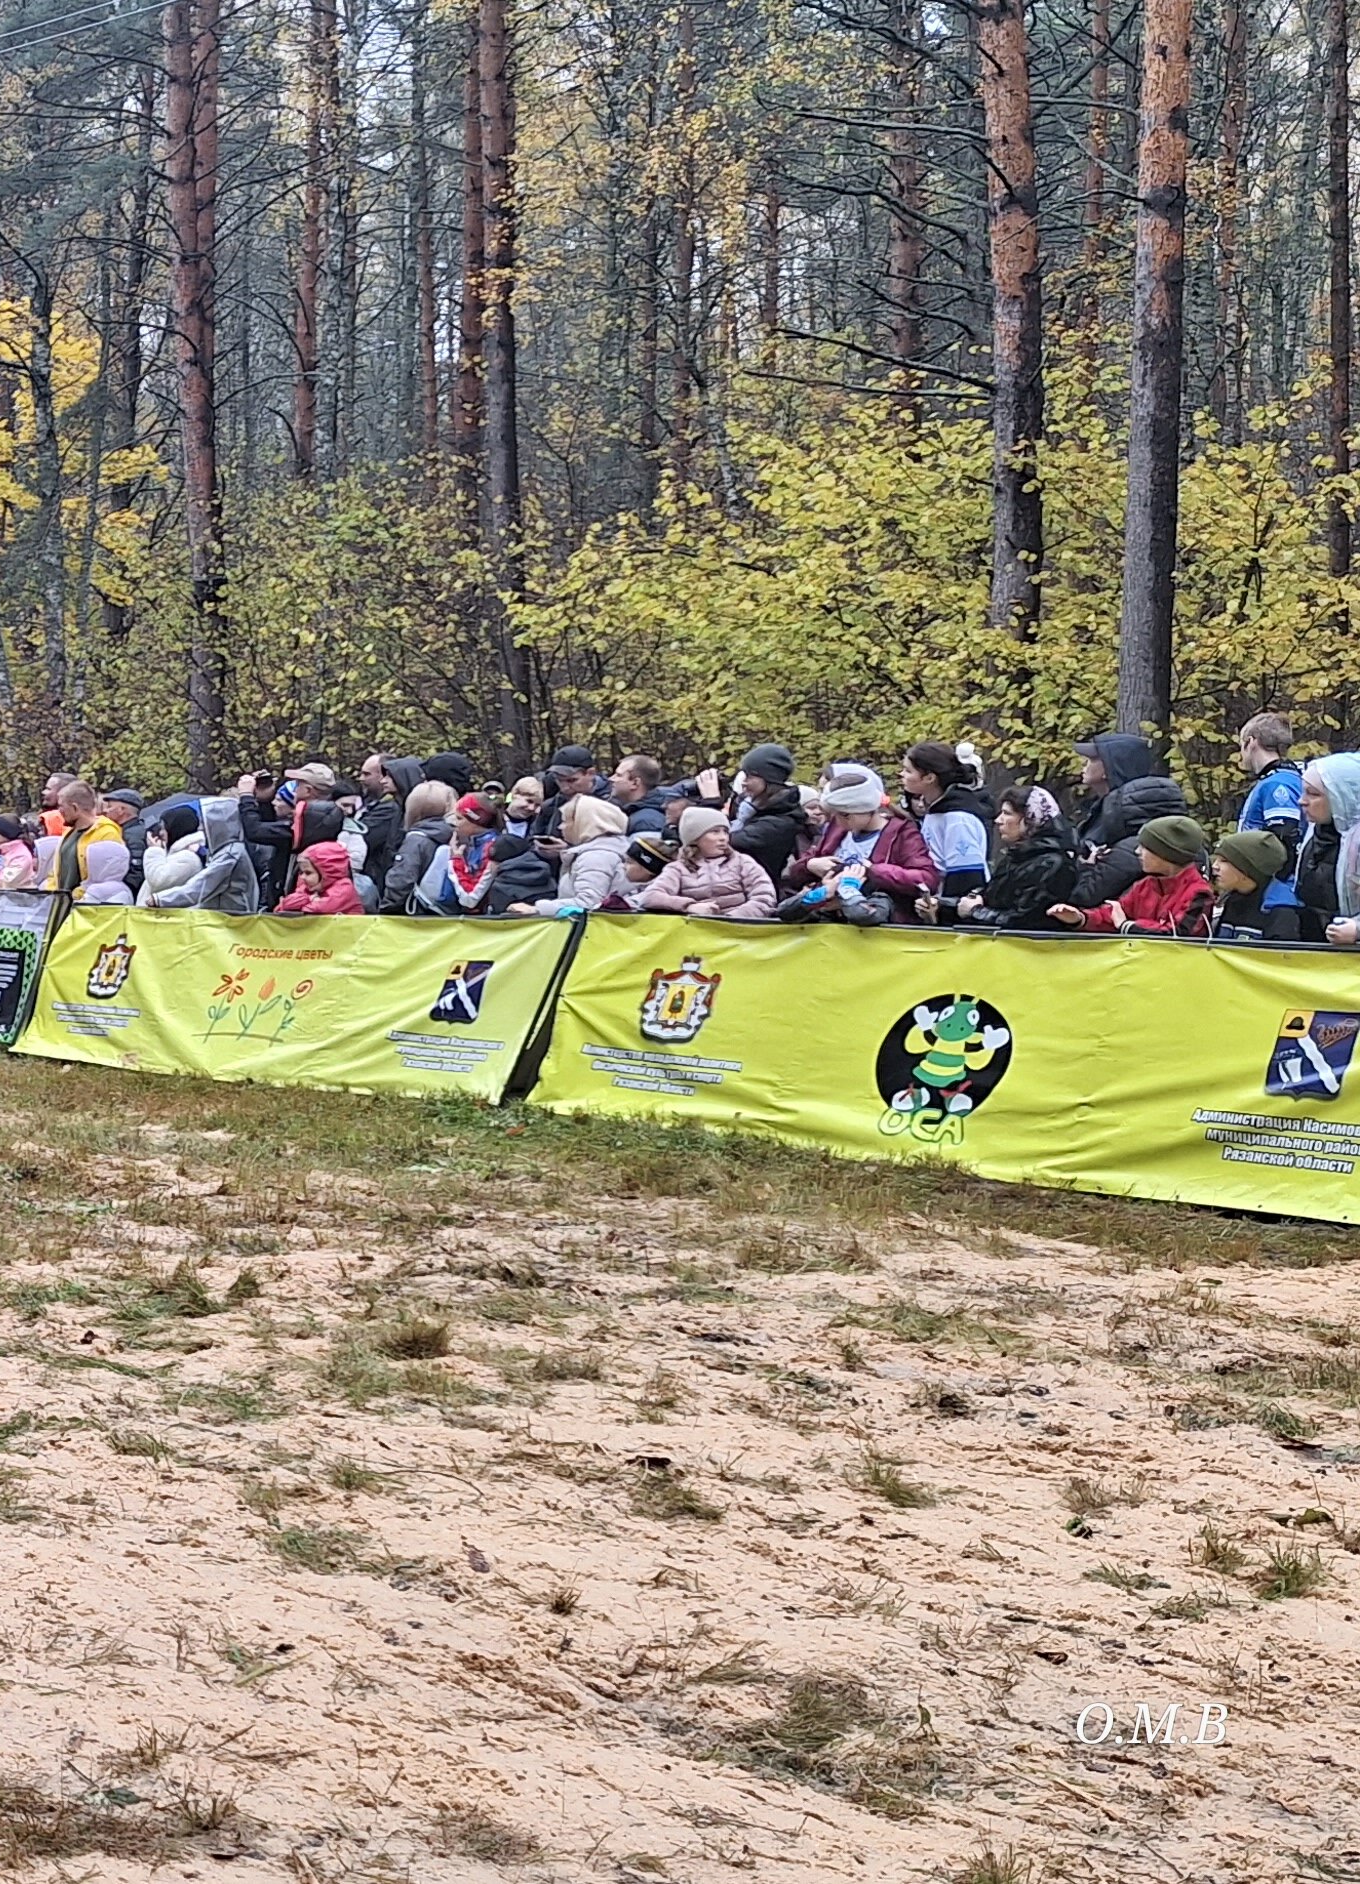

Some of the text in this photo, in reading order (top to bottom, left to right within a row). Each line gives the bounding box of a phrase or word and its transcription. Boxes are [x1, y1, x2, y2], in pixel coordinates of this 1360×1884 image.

[228, 943, 334, 961] Городские цветы
[878, 1107, 964, 1145] ОСА
[1191, 1108, 1301, 1131] Администрация
[1206, 1128, 1360, 1156] муниципального райо
[1222, 1146, 1354, 1174] Рязанской области
